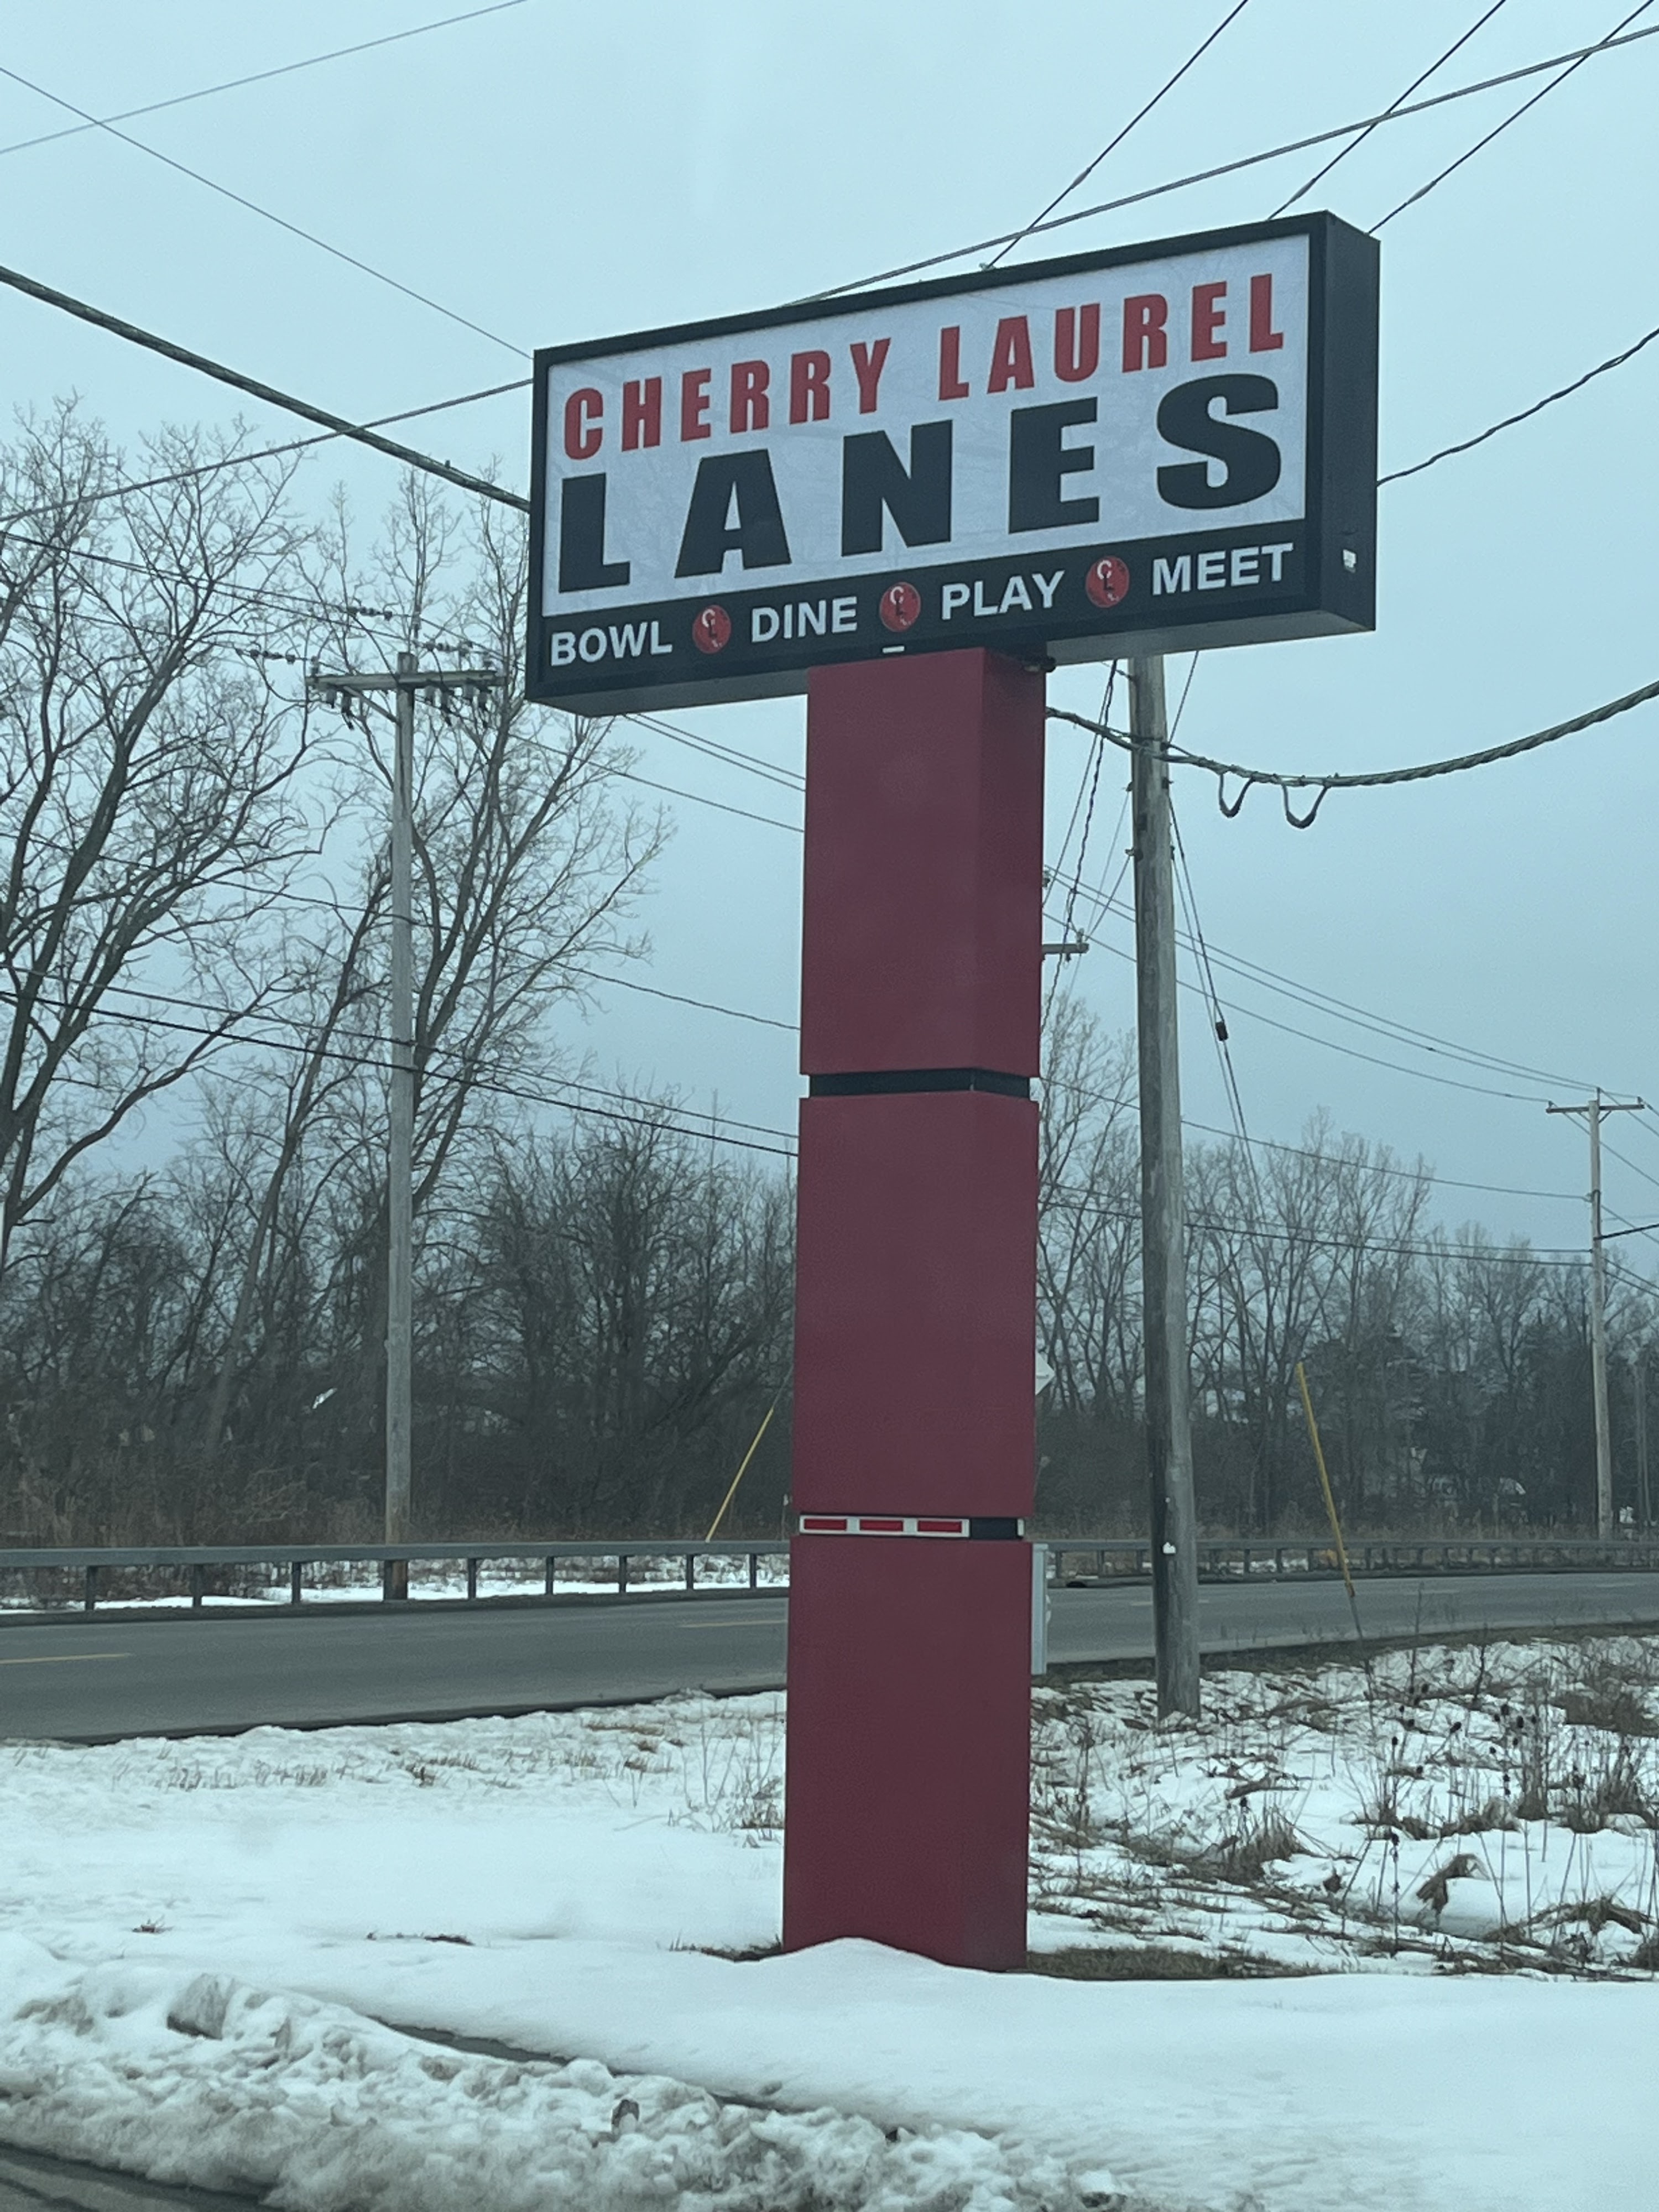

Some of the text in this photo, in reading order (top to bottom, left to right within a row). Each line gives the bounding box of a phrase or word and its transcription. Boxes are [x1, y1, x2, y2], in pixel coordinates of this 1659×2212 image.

[565, 274, 1284, 460] CHERRY LAUREL
[558, 374, 1281, 594] LANES
[551, 620, 672, 666] BOWL
[752, 597, 857, 643] DINE
[941, 570, 1065, 620] PLAY
[1152, 542, 1294, 596] MEET
